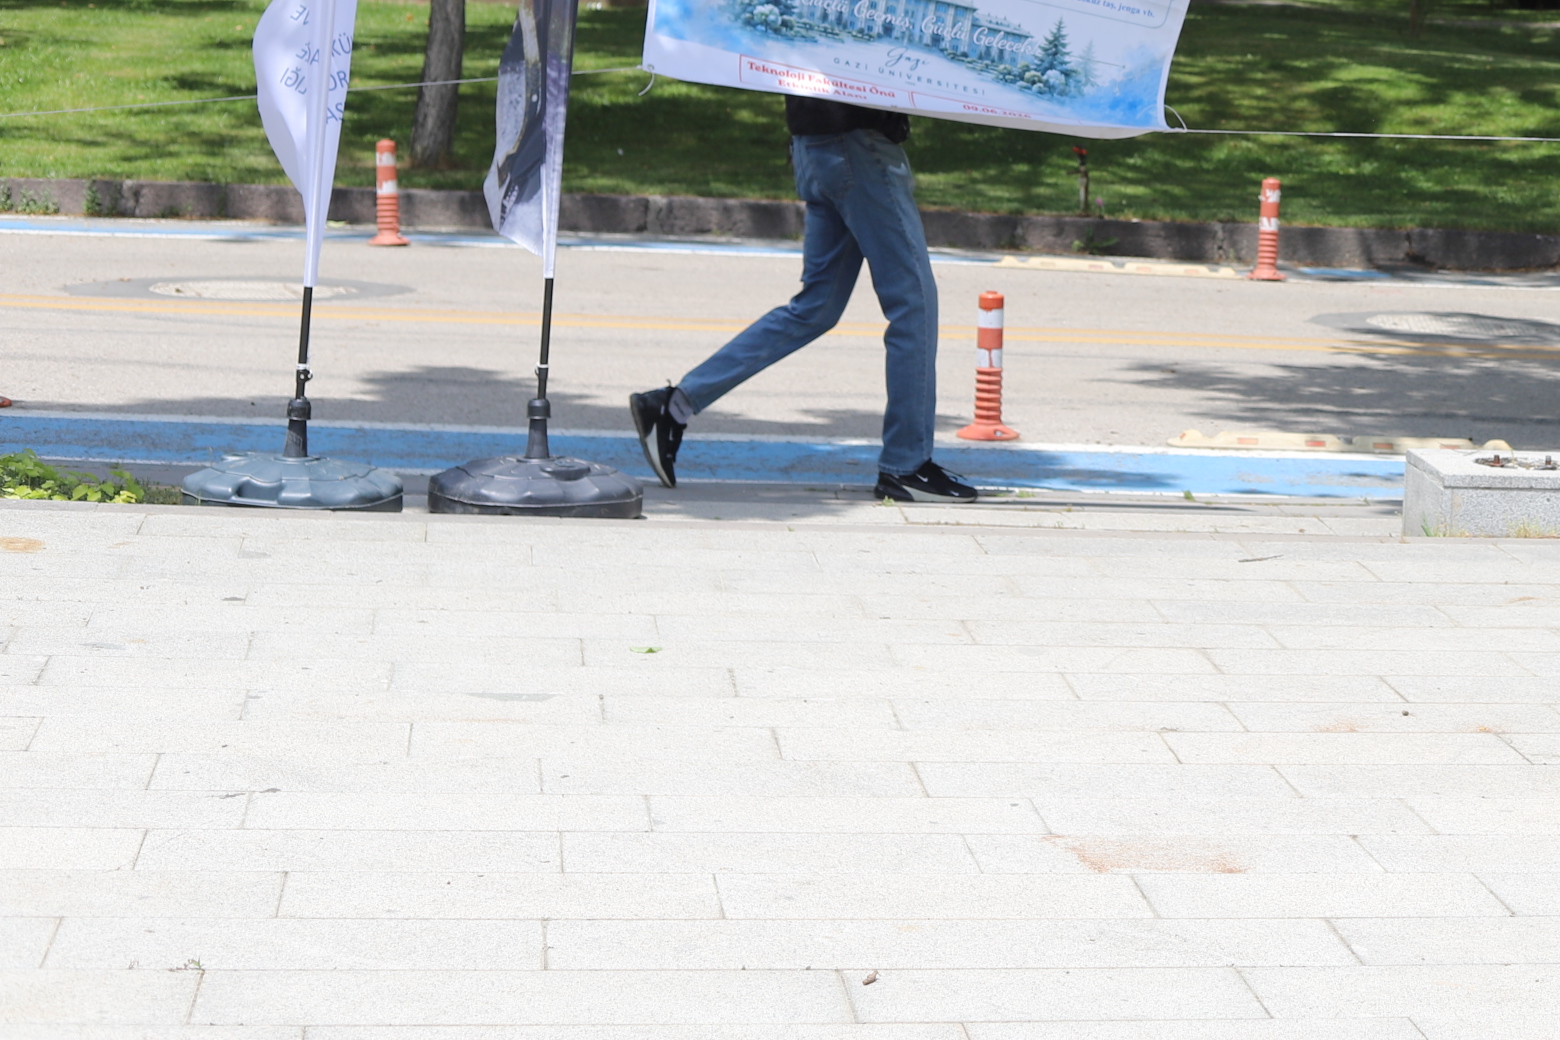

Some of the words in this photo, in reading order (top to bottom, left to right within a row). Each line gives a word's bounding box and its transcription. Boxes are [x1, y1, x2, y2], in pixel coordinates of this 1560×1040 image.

[1117, 2, 1141, 15] jenga
[747, 61, 806, 83] Teknoloji
[807, 70, 869, 93] Fakültesi
[869, 85, 896, 99] Önü
[878, 66, 987, 96] ÜNİVERSİTESİ
